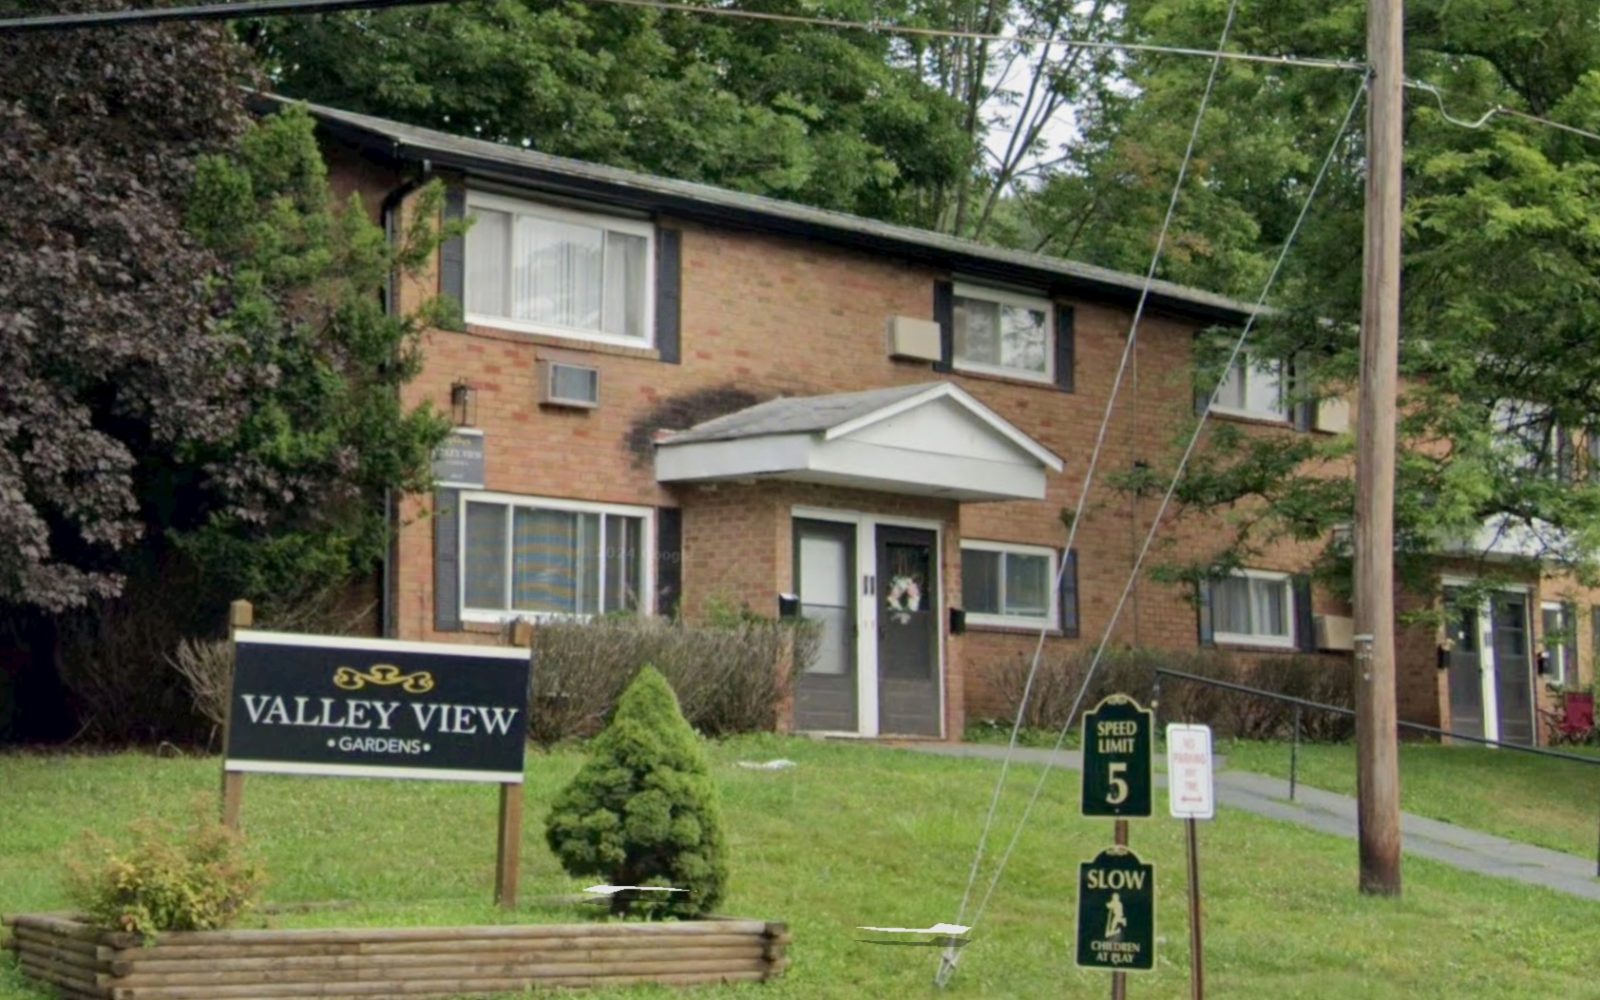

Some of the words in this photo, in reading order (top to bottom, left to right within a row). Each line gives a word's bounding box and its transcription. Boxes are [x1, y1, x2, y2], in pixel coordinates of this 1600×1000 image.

[241, 694, 401, 730] VALLEY
[410, 703, 519, 736] VIEW
[1097, 720, 1138, 736] SPEED
[338, 735, 421, 755] GARDENS
[1098, 738, 1135, 754] LIMIT
[1105, 762, 1129, 805] 5
[1087, 868, 1146, 890] SLOW
[1090, 940, 1141, 953] CHILDREN
